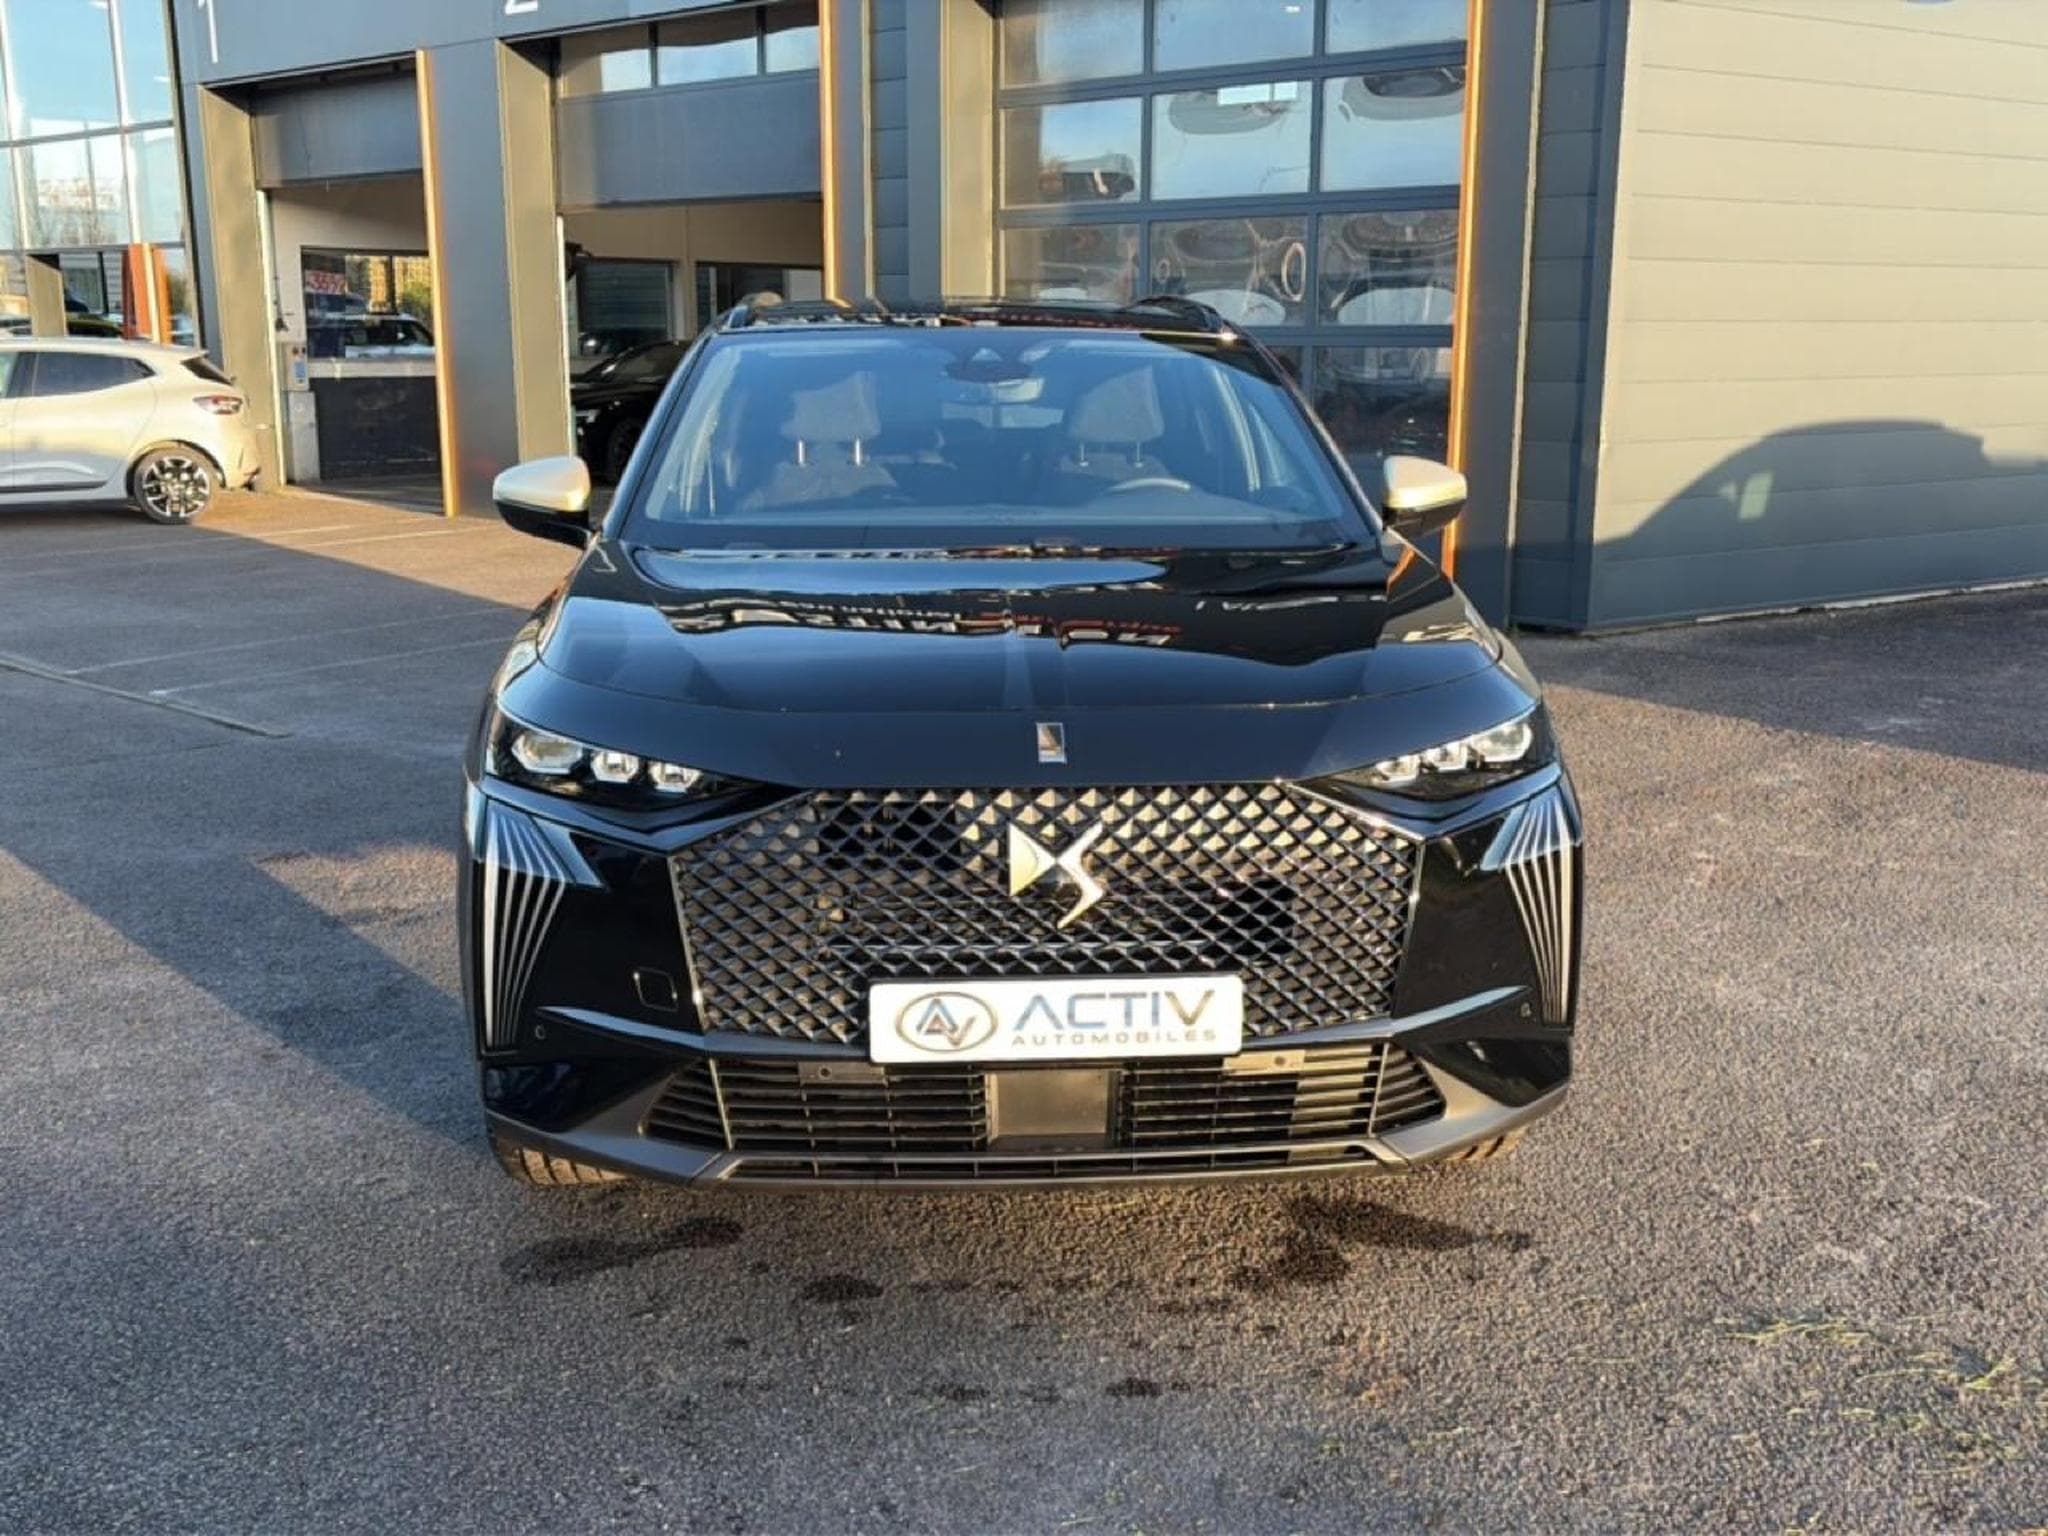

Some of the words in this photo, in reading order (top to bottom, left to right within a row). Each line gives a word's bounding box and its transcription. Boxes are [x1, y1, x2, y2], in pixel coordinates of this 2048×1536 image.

[198, 0, 218, 63] 1
[1013, 989, 1215, 1031] ACTIV
[1011, 1029, 1217, 1047] AUTOMOBILES
